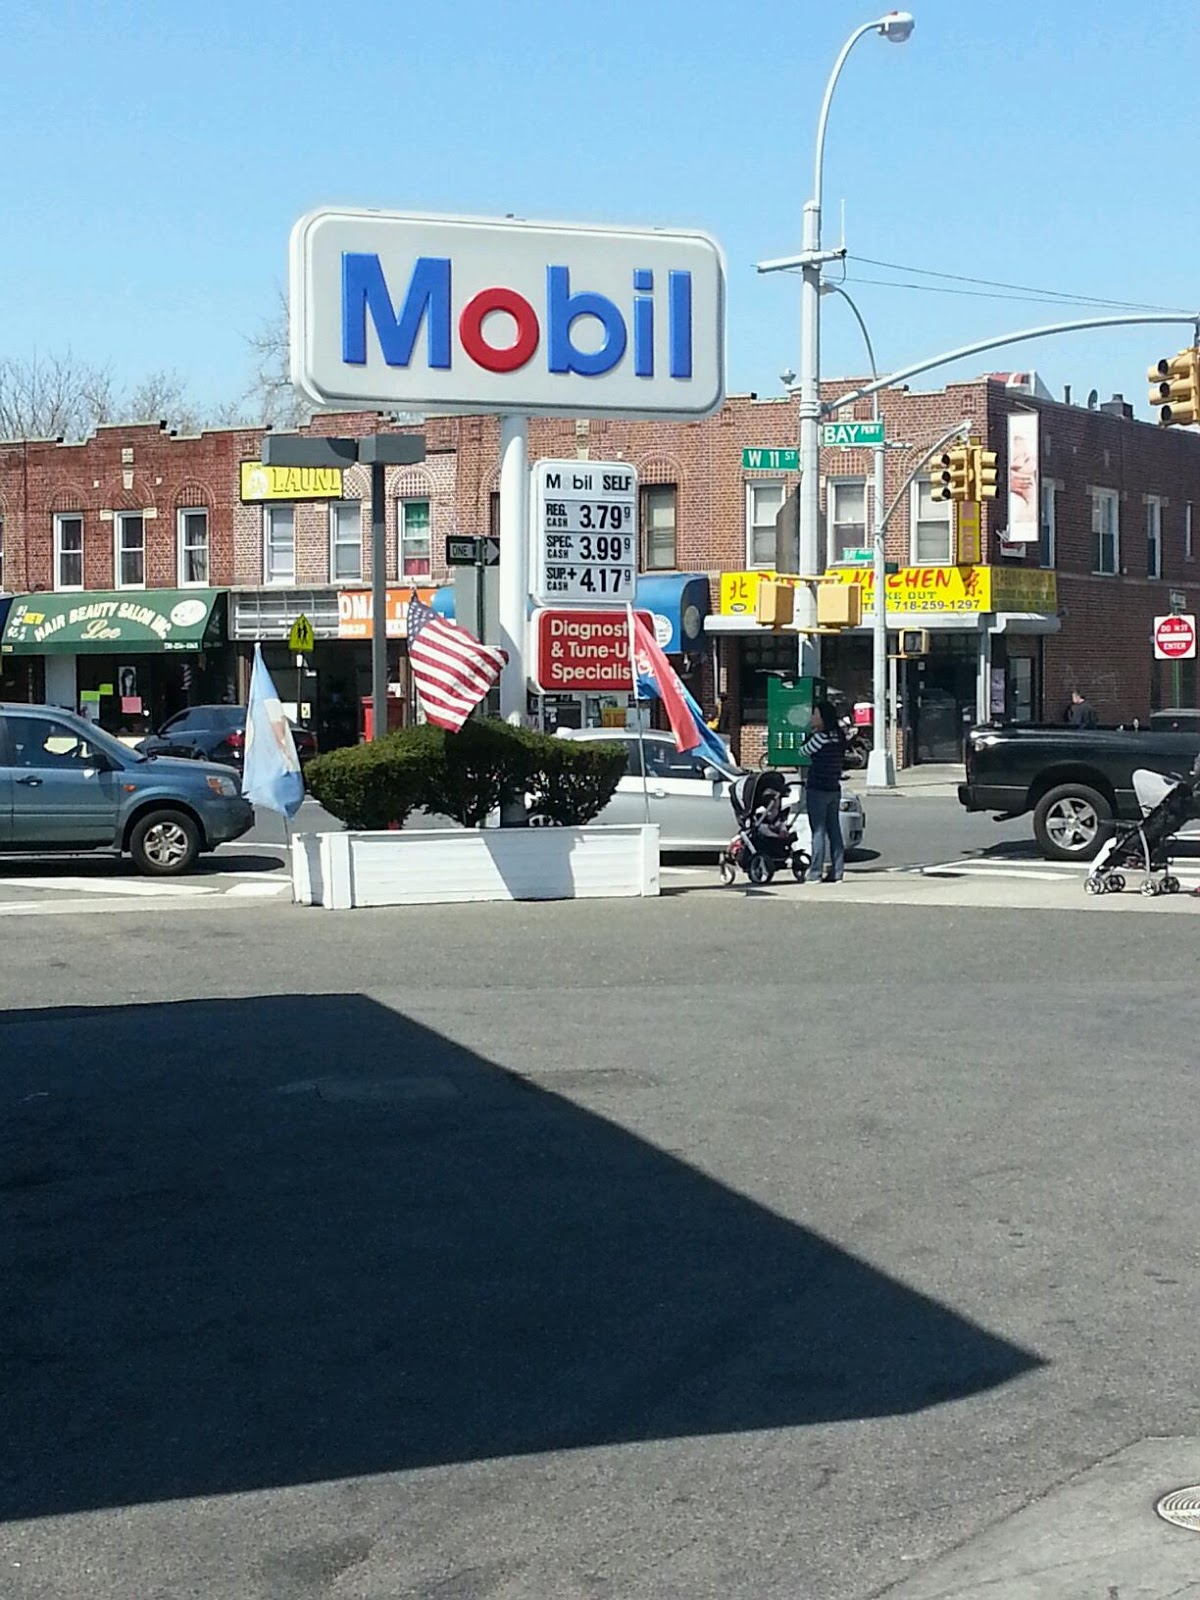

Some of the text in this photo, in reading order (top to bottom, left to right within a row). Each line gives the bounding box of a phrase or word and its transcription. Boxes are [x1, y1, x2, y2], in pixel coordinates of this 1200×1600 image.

[341, 250, 692, 379] Mobil
[824, 425, 859, 442] BAY
[748, 450, 794, 467] W 11 ST
[546, 473, 632, 491] Mbil SELF
[546, 503, 568, 516] REG.
[547, 518, 568, 527] CASH
[546, 535, 574, 548] SPEC.
[452, 545, 468, 557] ONE
[547, 549, 568, 559] CASH
[547, 581, 568, 591] CASH
[852, 569, 952, 588] KICHEN
[864, 591, 937, 600] TKE OUT
[894, 599, 980, 611] 718-259-1297
[33, 614, 66, 642] HAIR
[69, 602, 120, 624] BEAUTY
[117, 602, 156, 627] SALON
[80, 619, 121, 639] Lee
[551, 619, 629, 640] Diagnost
[551, 641, 564, 658] &
[551, 663, 632, 683] Specialis
